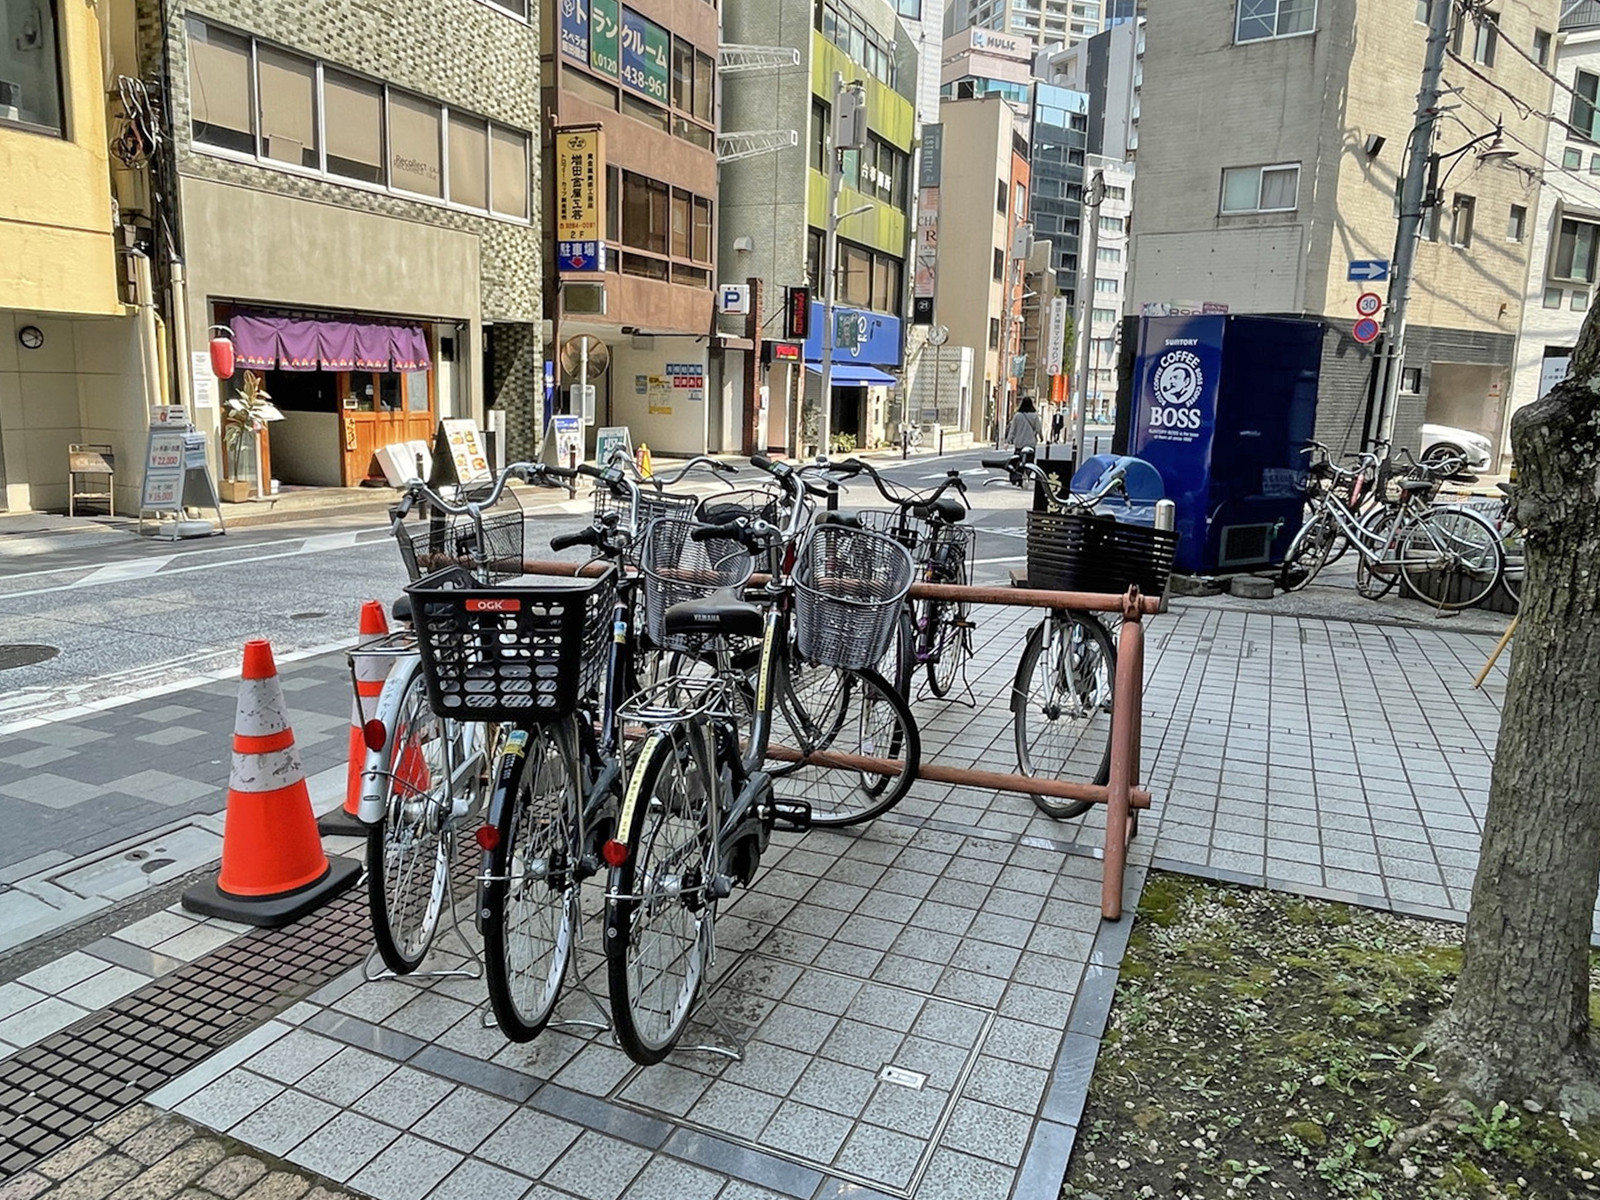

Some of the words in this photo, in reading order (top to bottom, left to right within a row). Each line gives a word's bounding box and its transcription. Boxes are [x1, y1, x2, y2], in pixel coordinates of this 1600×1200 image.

[987, 36, 1016, 51] HULIC
[560, 242, 595, 257] 駐車場
[724, 291, 740, 309] P
[1361, 297, 1376, 311] 30
[1160, 350, 1200, 368] COFFEE
[1149, 406, 1201, 429] BOSS
[477, 599, 505, 610] OGK
[693, 614, 720, 622] YAMAHA
